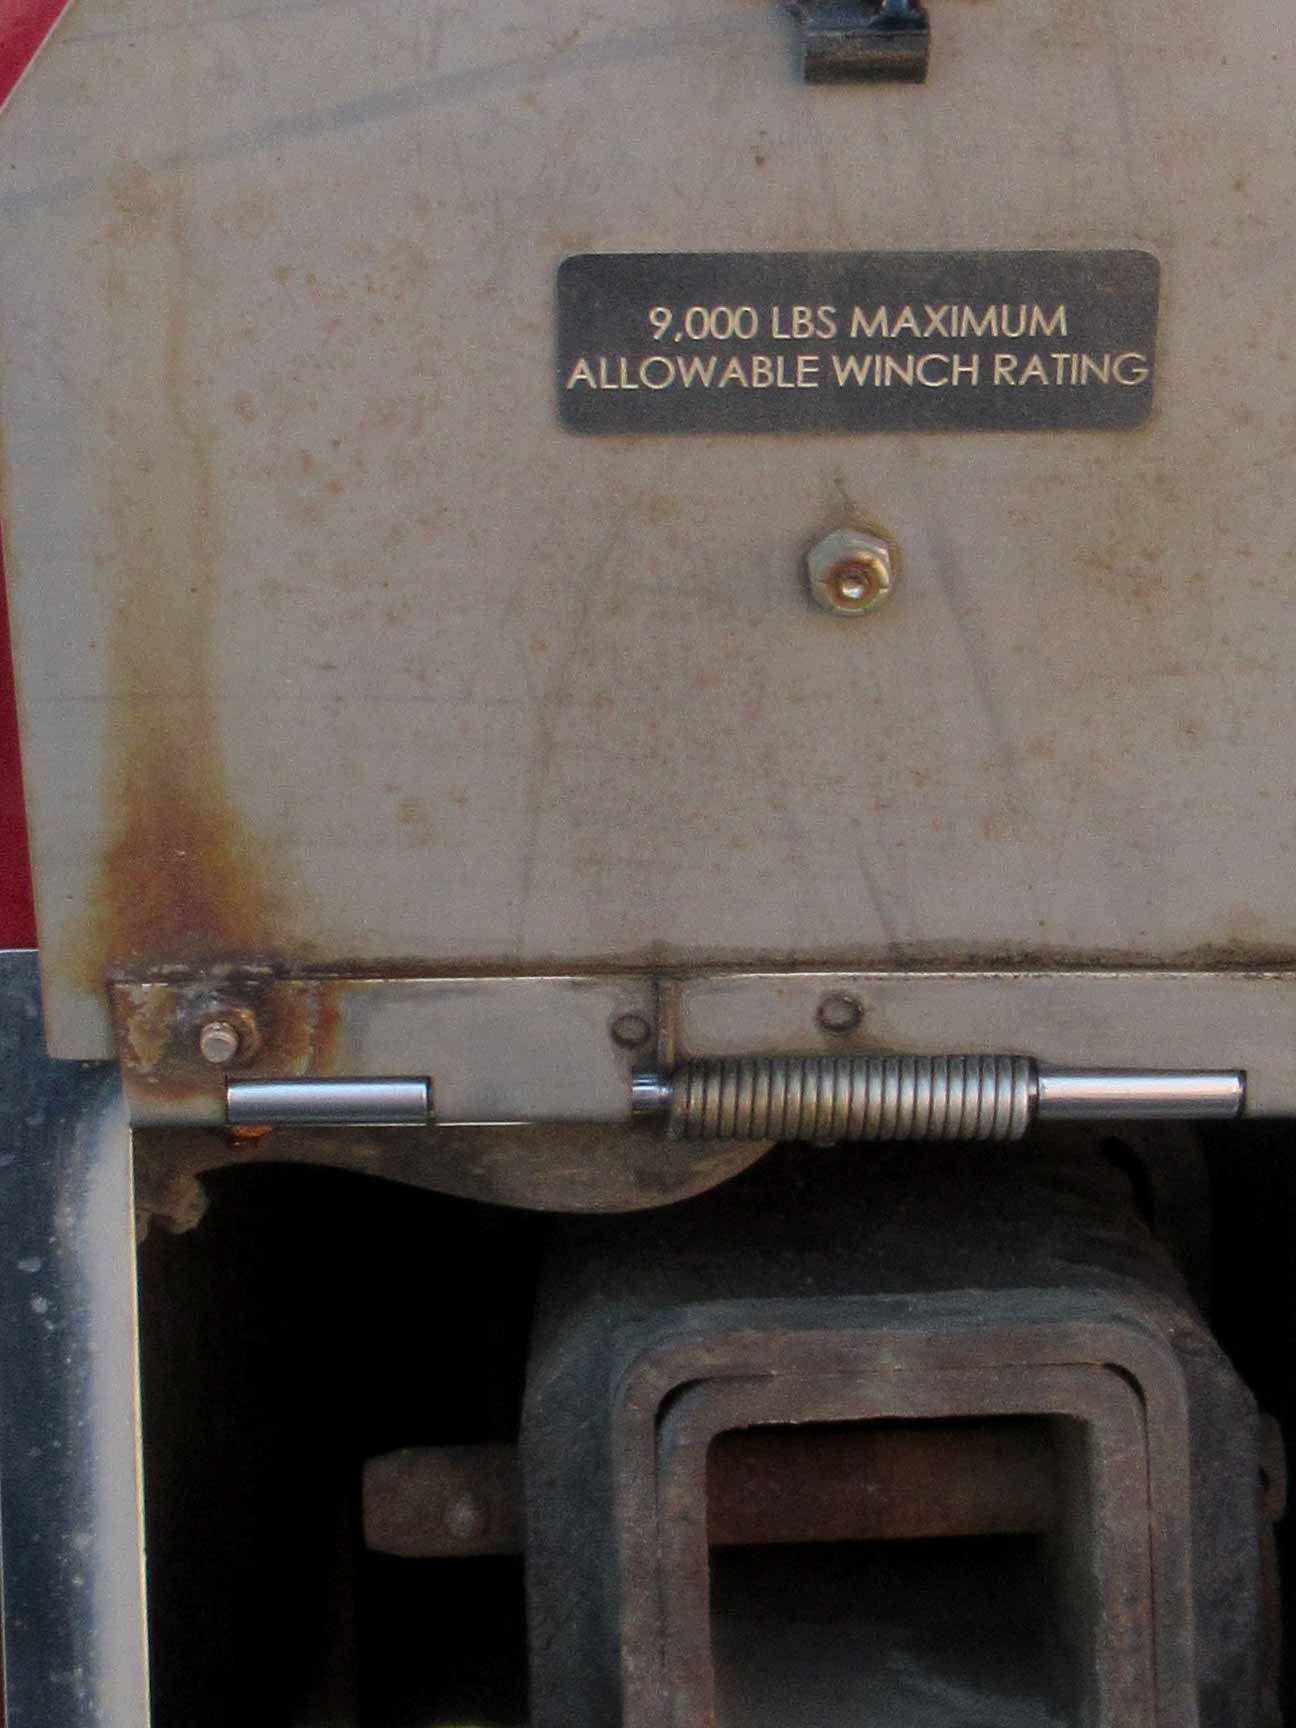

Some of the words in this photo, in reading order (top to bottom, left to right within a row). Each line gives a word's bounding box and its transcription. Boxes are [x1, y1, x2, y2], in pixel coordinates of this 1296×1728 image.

[648, 305, 759, 343] 9,000
[771, 305, 837, 340] LBS
[850, 304, 1068, 340] MAXIMUM
[566, 355, 819, 390] ALLOWABLE
[832, 353, 979, 388] WINCH
[994, 351, 1150, 386] RATING
